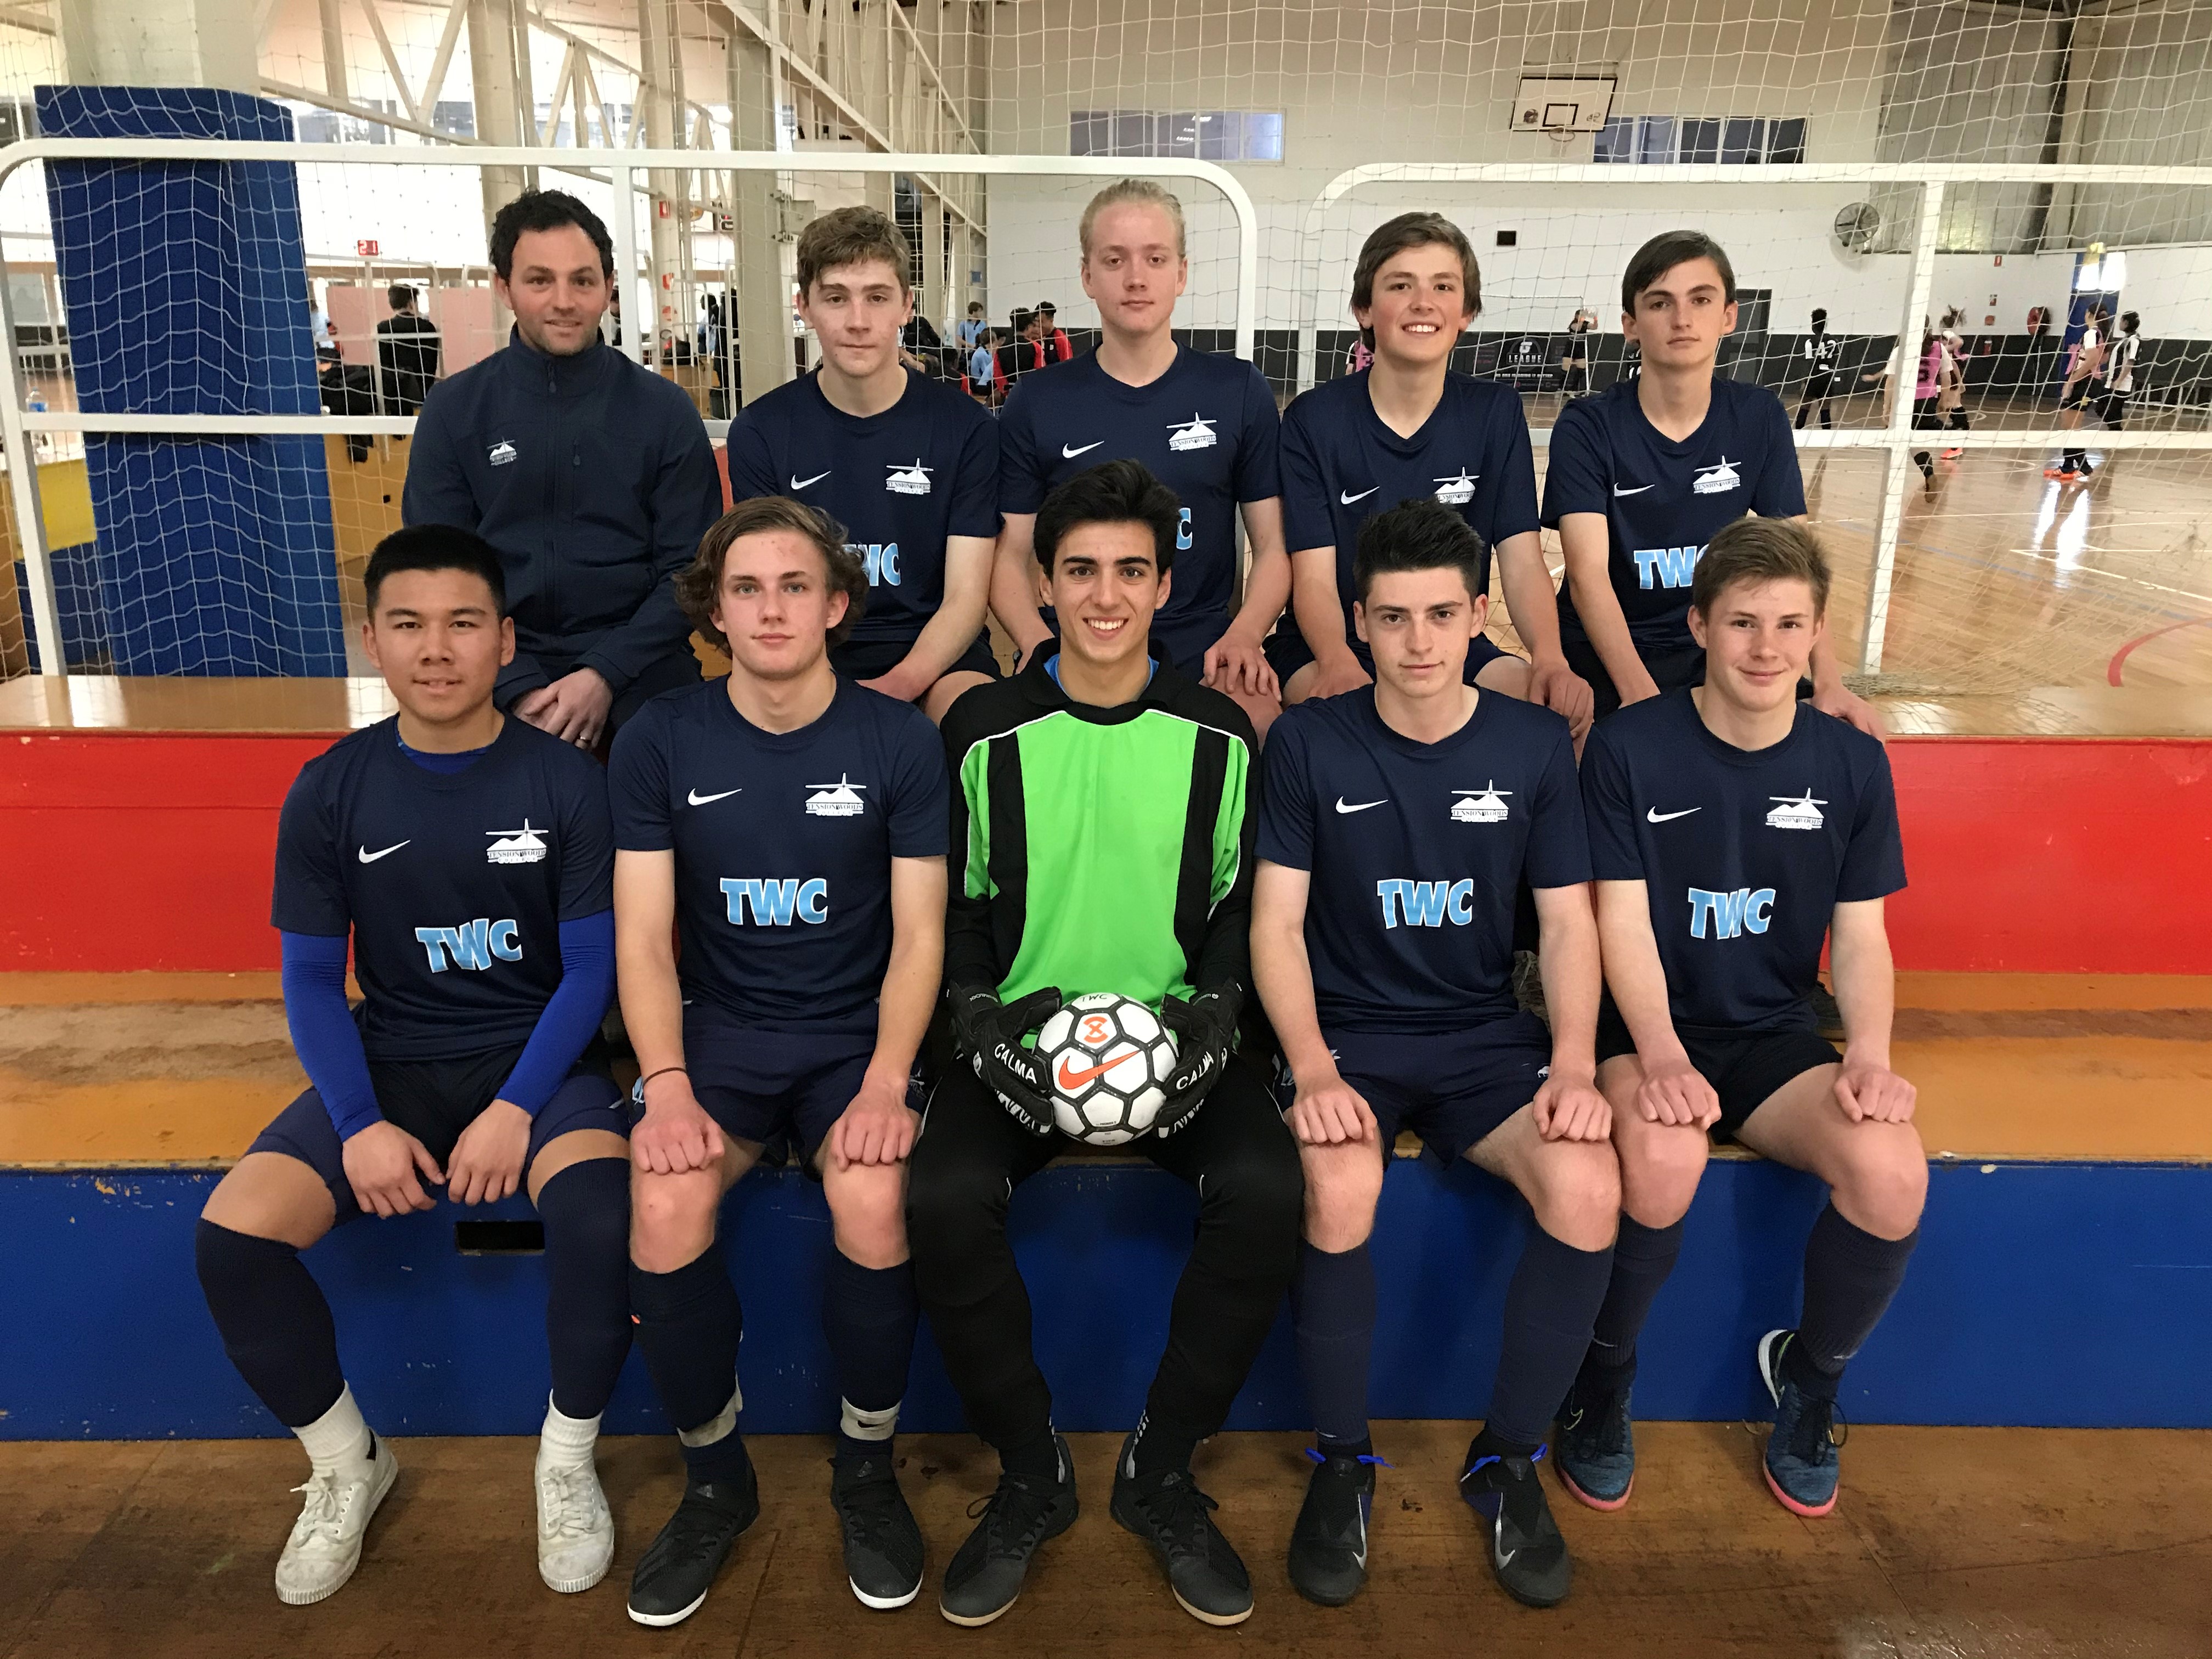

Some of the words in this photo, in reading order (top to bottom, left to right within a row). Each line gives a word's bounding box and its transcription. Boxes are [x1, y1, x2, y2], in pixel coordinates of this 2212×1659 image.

[1509, 354, 1542, 363] LEAGUE
[1634, 544, 1709, 590] TW
[720, 877, 828, 926] TWC
[1377, 878, 1474, 929] TWC
[1688, 887, 1776, 940] TWC
[415, 918, 523, 974] TWC
[994, 1043, 1037, 1084] CALMA
